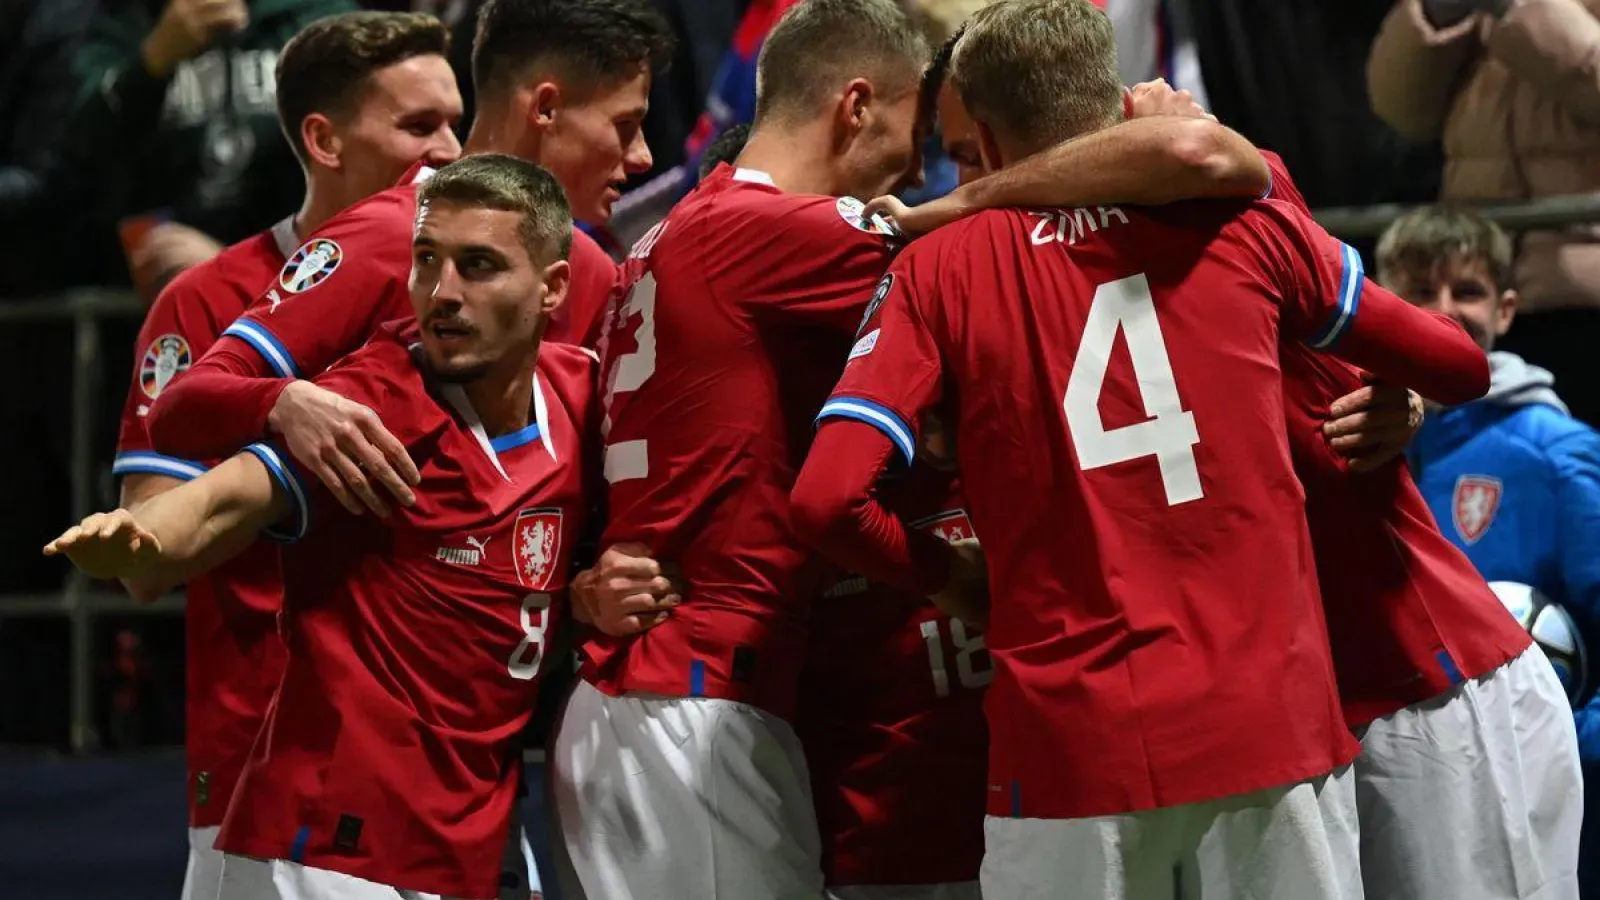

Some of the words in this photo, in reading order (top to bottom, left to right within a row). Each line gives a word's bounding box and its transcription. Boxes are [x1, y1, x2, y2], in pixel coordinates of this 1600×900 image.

[1028, 206, 1129, 246] ZIMA
[1063, 272, 1204, 506] 4
[435, 547, 480, 565] PUMA
[507, 583, 551, 680] 8
[919, 615, 995, 698] 18
